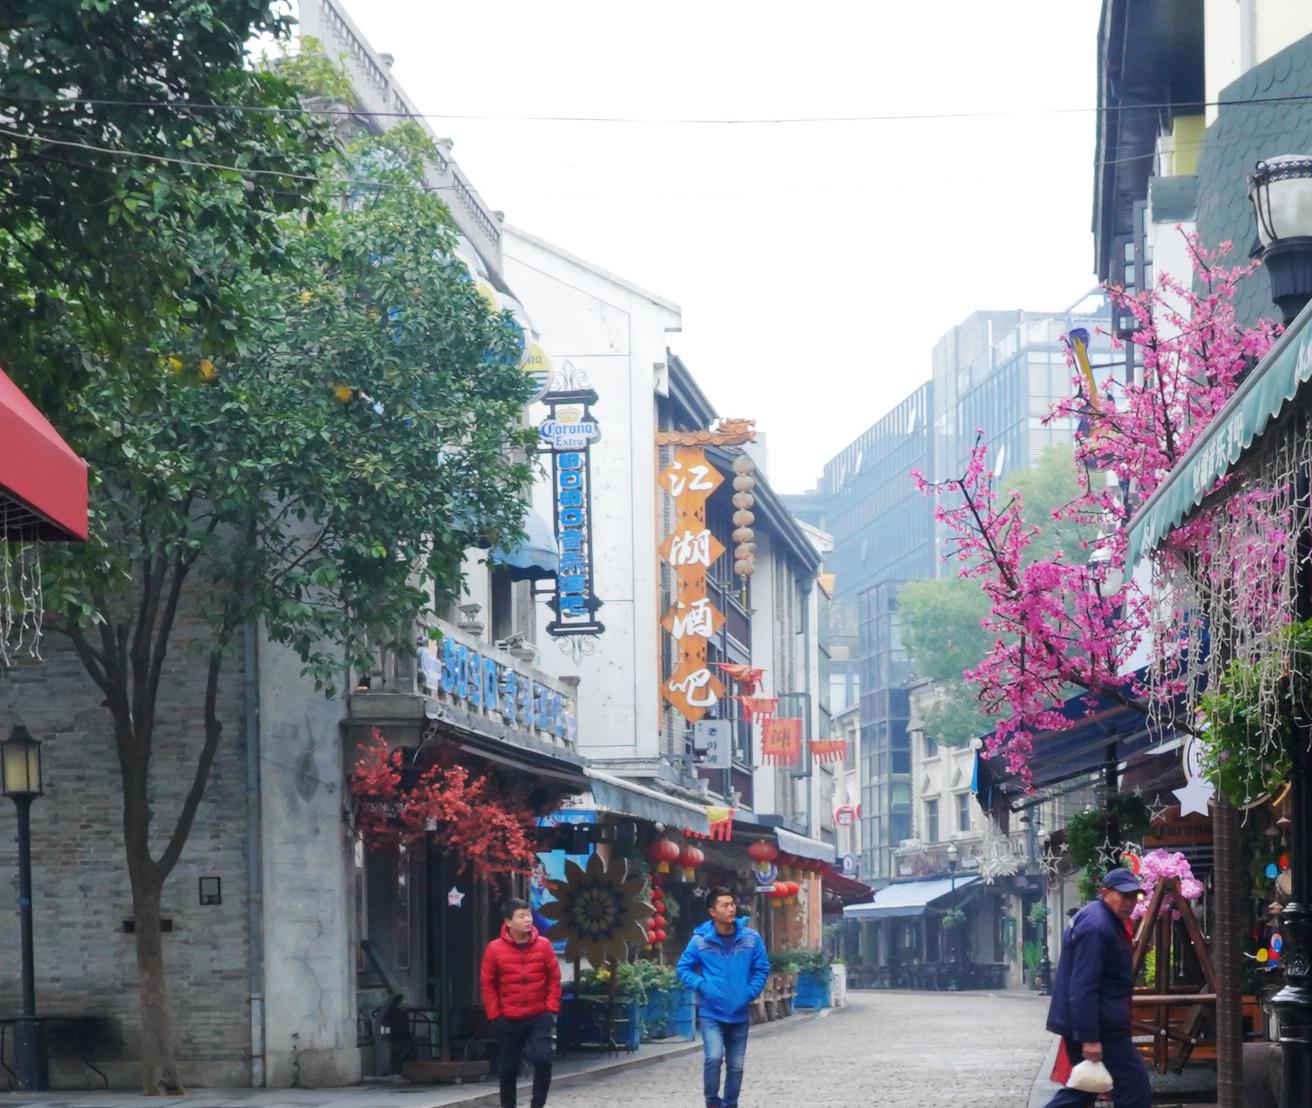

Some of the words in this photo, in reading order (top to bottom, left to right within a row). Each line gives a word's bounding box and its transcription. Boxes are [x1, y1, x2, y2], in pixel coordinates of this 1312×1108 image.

[540, 422, 593, 439] Corona
[554, 436, 584, 447] Extra
[668, 461, 717, 707] 江湖酒吧
